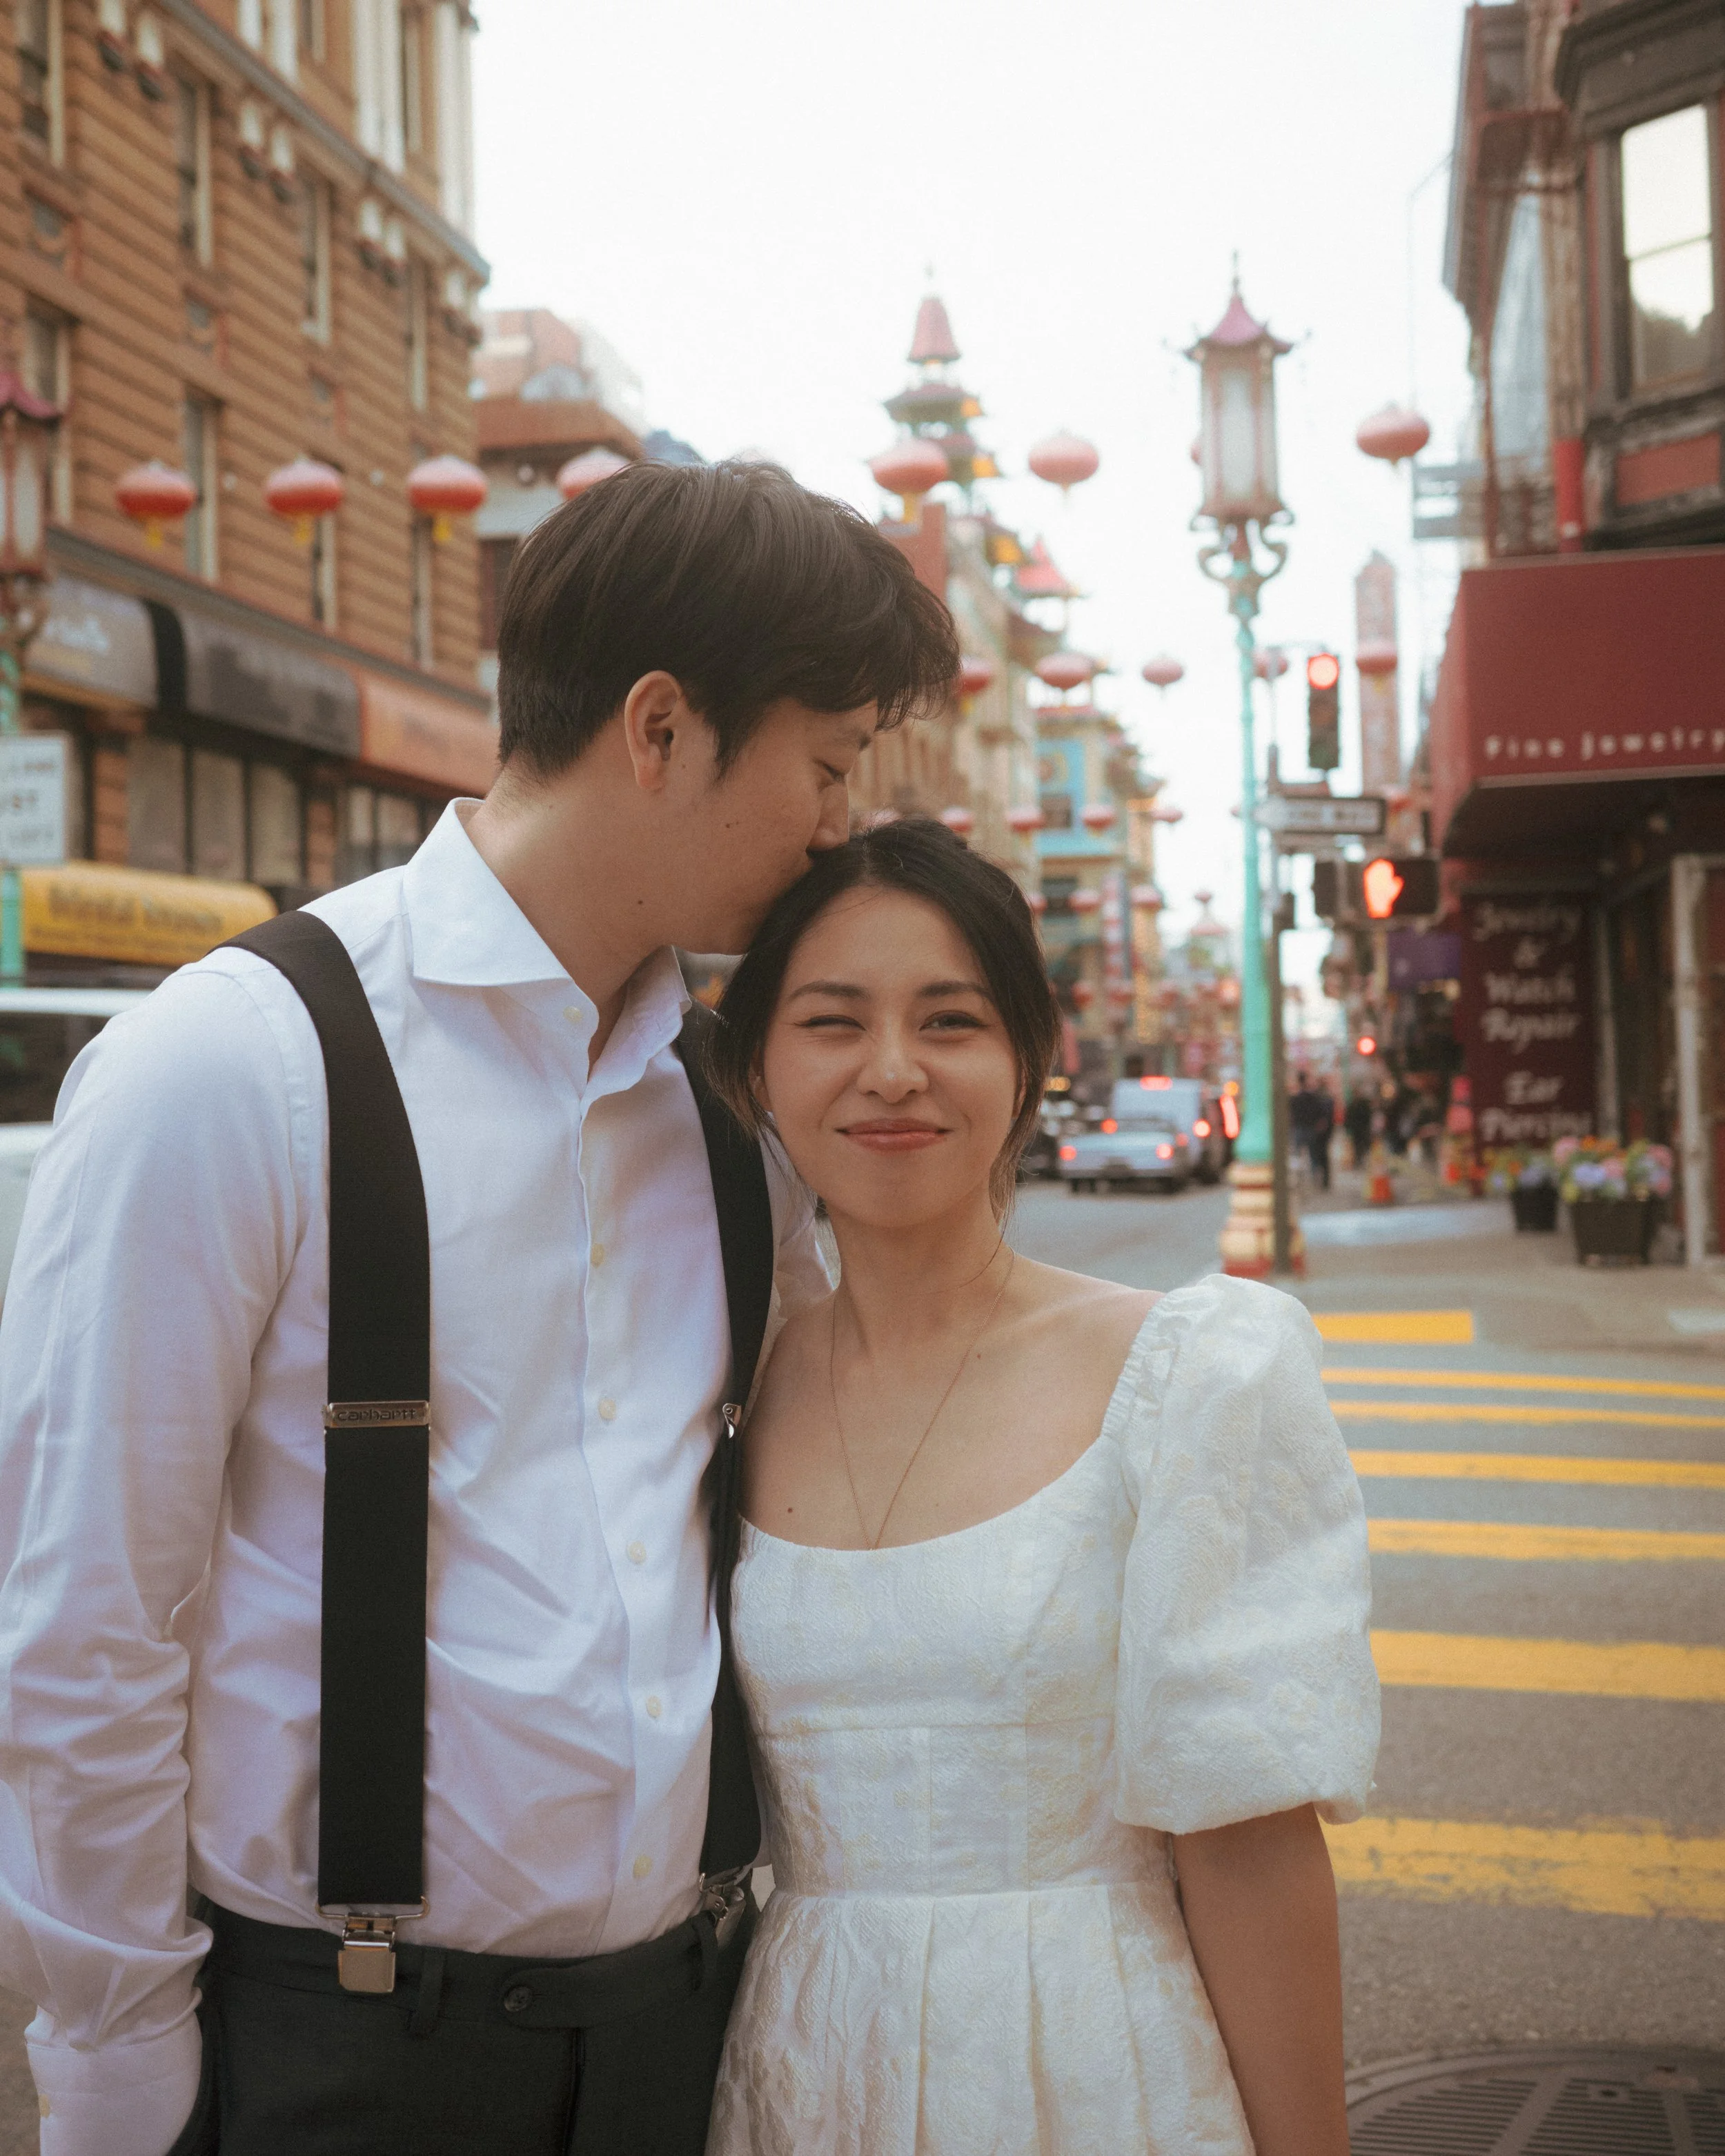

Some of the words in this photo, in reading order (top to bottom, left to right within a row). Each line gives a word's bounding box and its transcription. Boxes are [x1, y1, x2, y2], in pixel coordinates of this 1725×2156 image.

[1484, 733, 1566, 760] Fine
[1472, 900, 1581, 944] Jewelry
[1515, 935, 1549, 969] &
[1485, 964, 1576, 1005] Watch
[1481, 1007, 1581, 1055] Repair
[1505, 1070, 1564, 1105] Ear
[337, 1408, 416, 1421] carhartt
